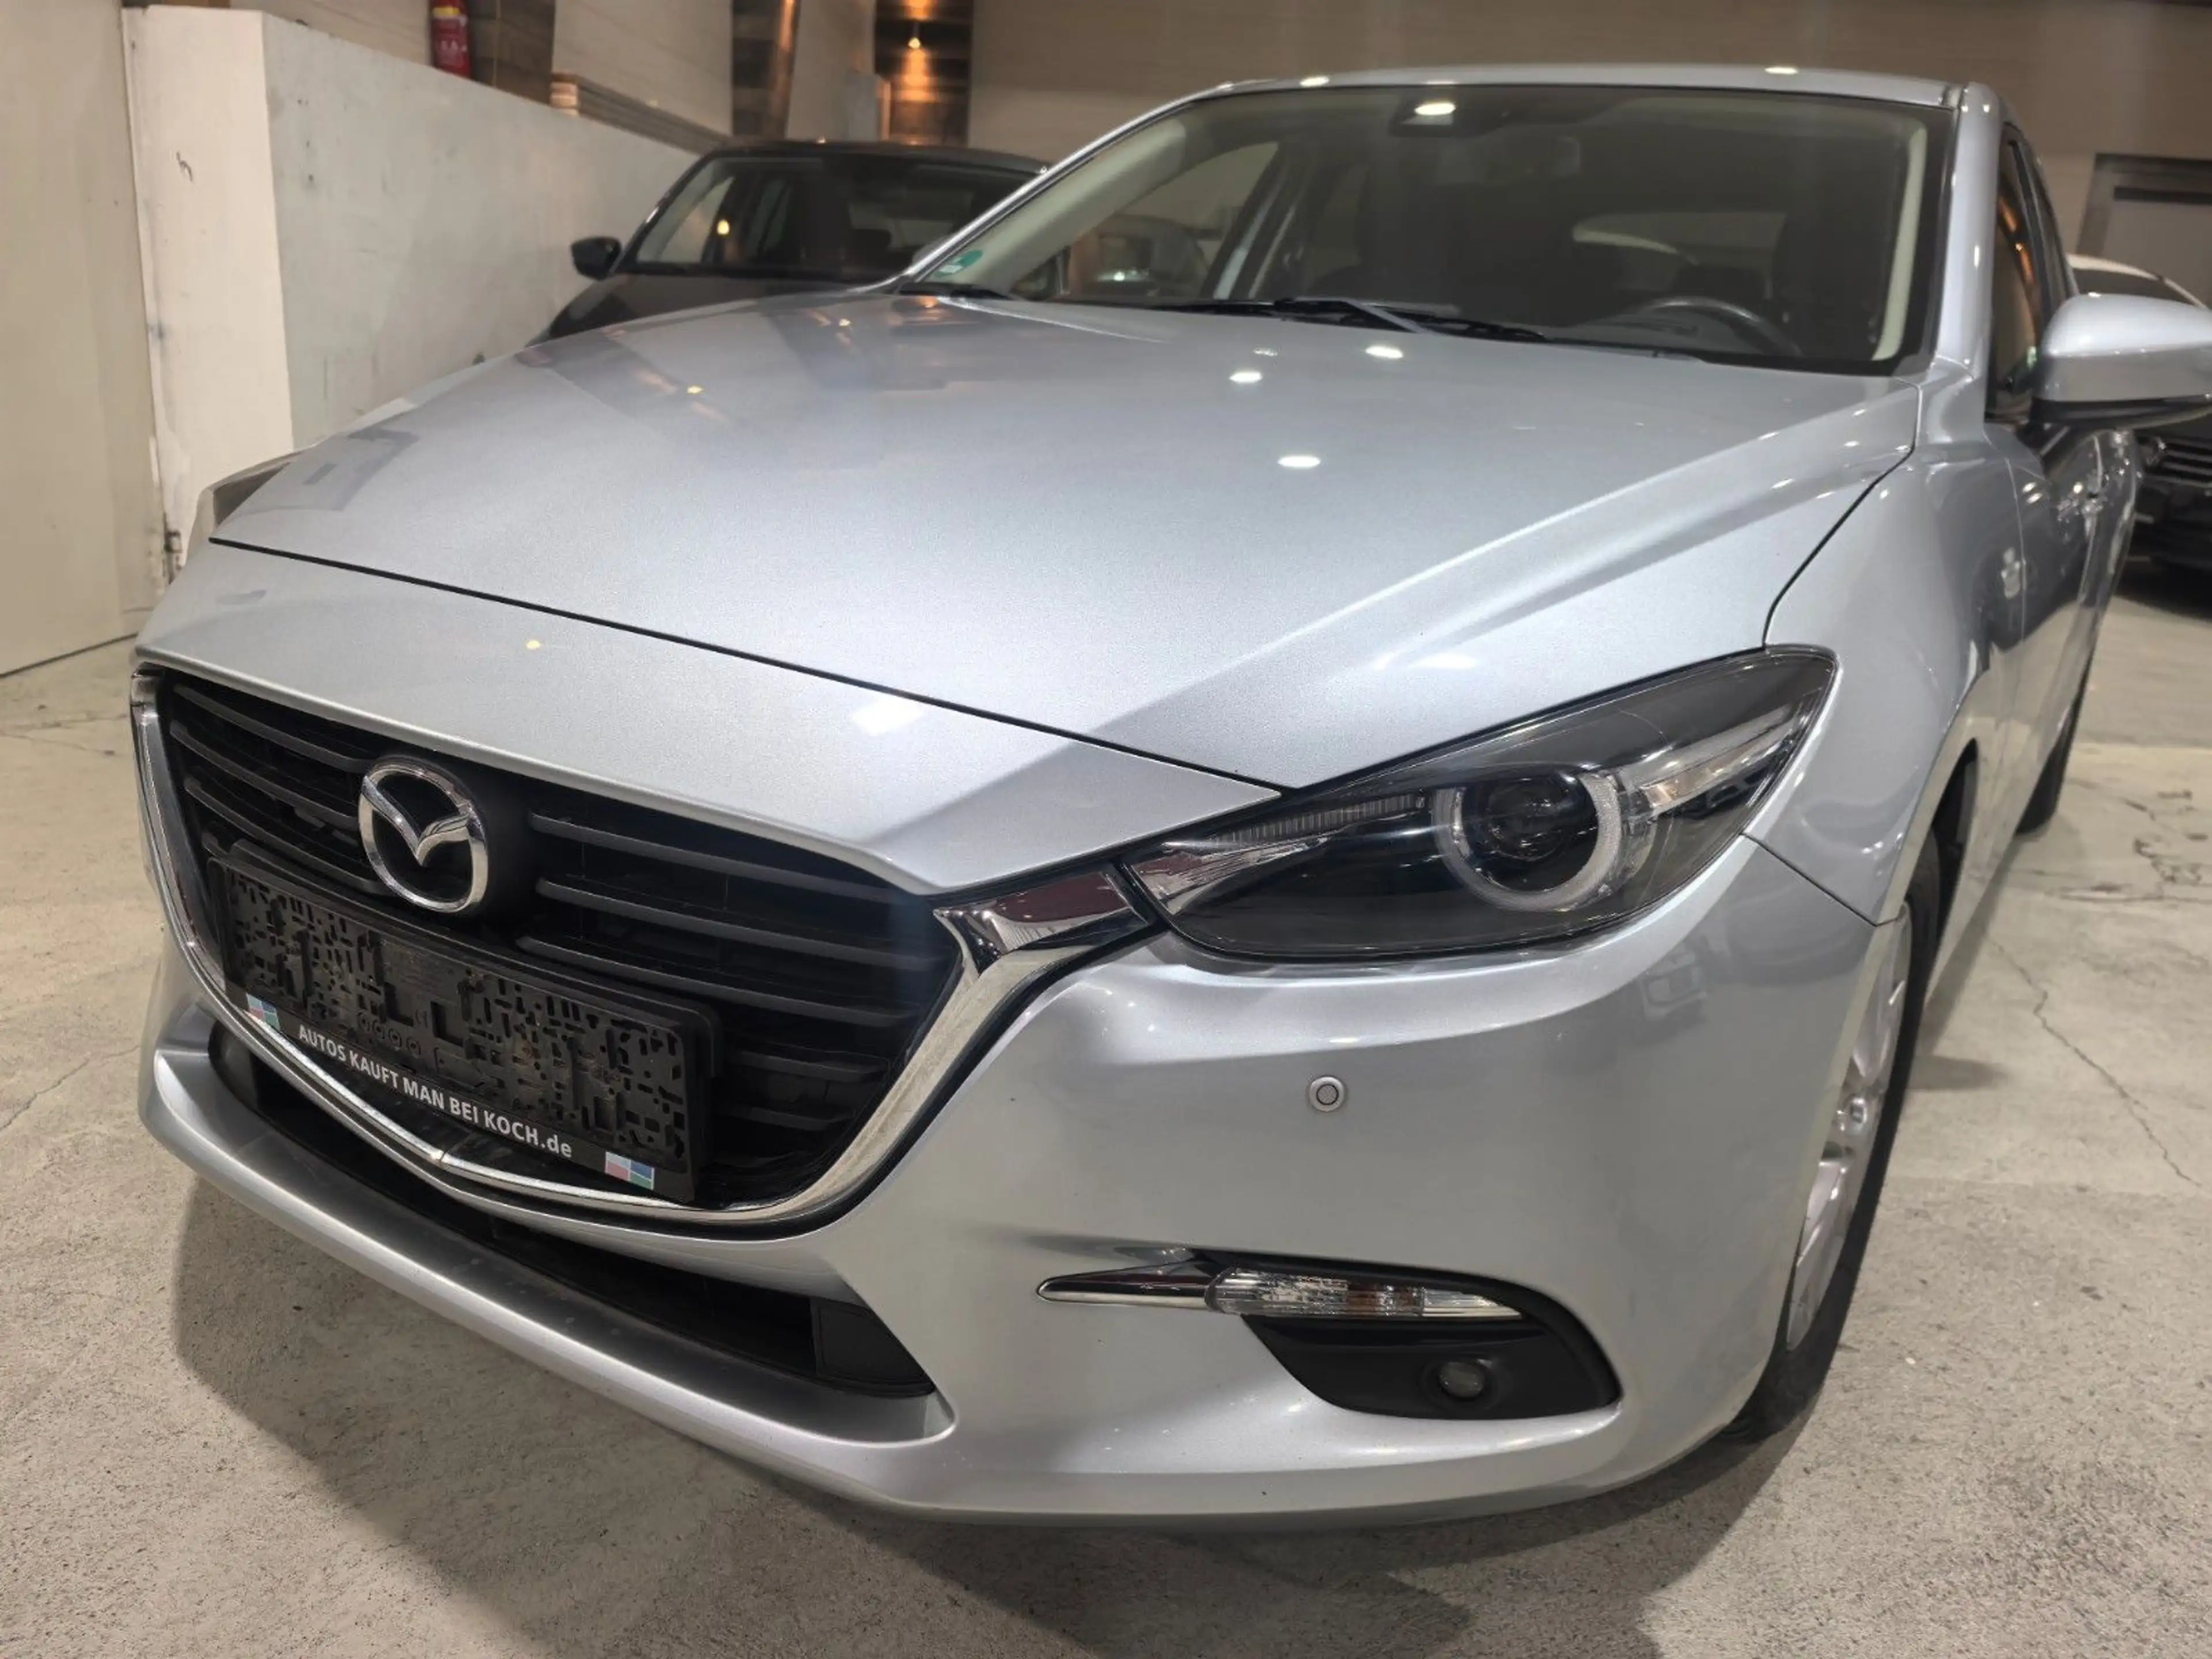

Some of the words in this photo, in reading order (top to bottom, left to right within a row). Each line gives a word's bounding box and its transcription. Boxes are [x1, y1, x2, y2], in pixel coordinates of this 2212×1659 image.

[299, 1024, 346, 1061] AUTOS
[349, 1050, 399, 1088] KAUFT
[403, 1077, 445, 1109] MAN
[449, 1096, 478, 1123] BEI
[484, 1110, 572, 1158] KOCH.de
